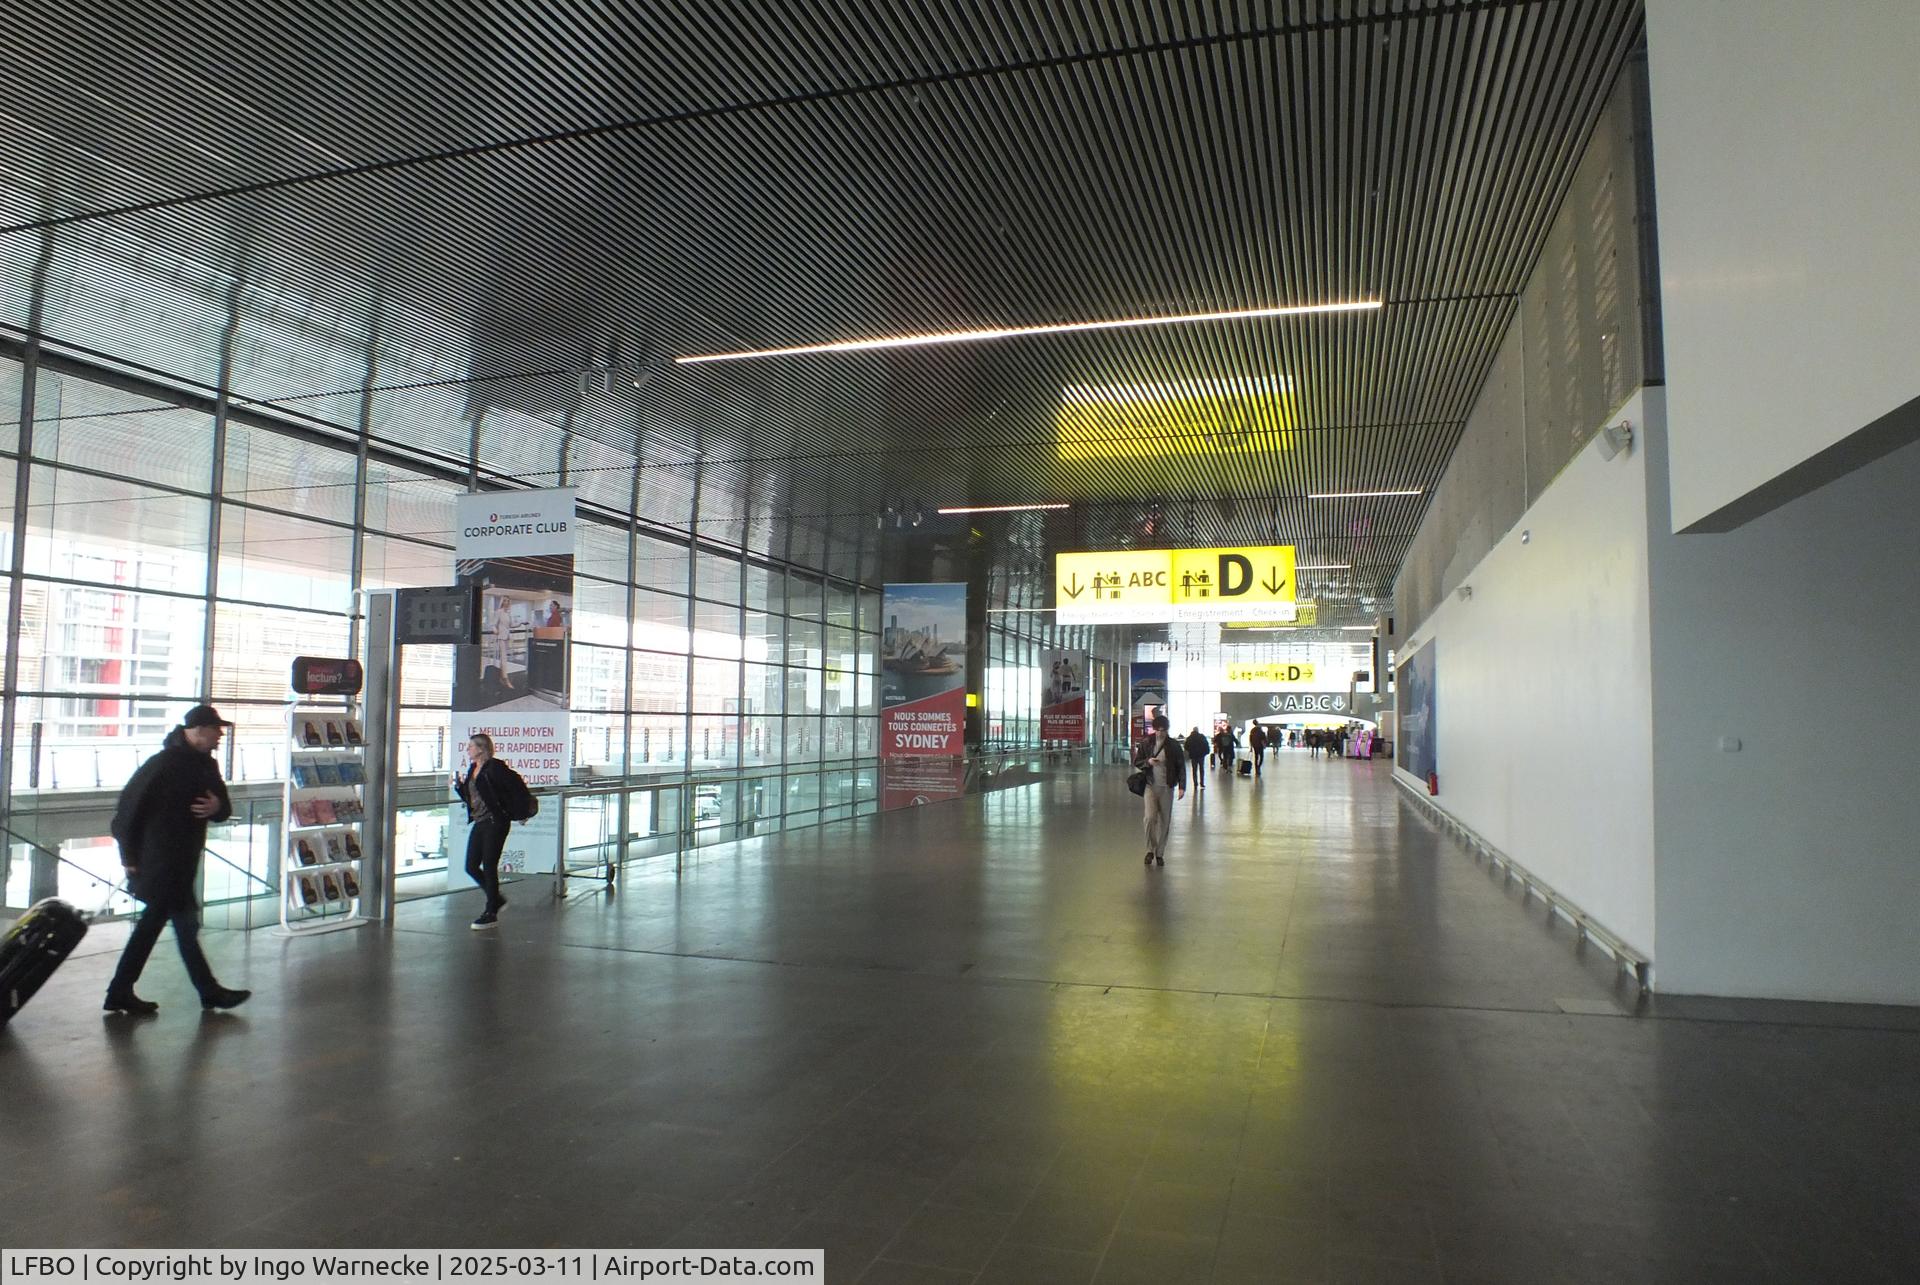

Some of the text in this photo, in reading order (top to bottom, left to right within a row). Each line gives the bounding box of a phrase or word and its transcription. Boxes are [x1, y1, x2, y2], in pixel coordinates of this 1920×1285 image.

[464, 522, 567, 537] CORPORATE CLUB
[1128, 554, 1254, 597] ABC D
[1178, 608, 1243, 619] Enregistrement
[1288, 666, 1300, 681] D
[894, 712, 951, 721] NOUS SOMMES
[468, 727, 554, 737] LE MEILLEUR MOYEN
[888, 721, 957, 732] TOUS CONNECTÉS
[895, 734, 949, 749] SYDNEY
[507, 743, 564, 753] RAPIDEMENT
[517, 759, 540, 769] AVEC
[543, 759, 560, 769] DES
[522, 775, 559, 785] CLUSIFS
